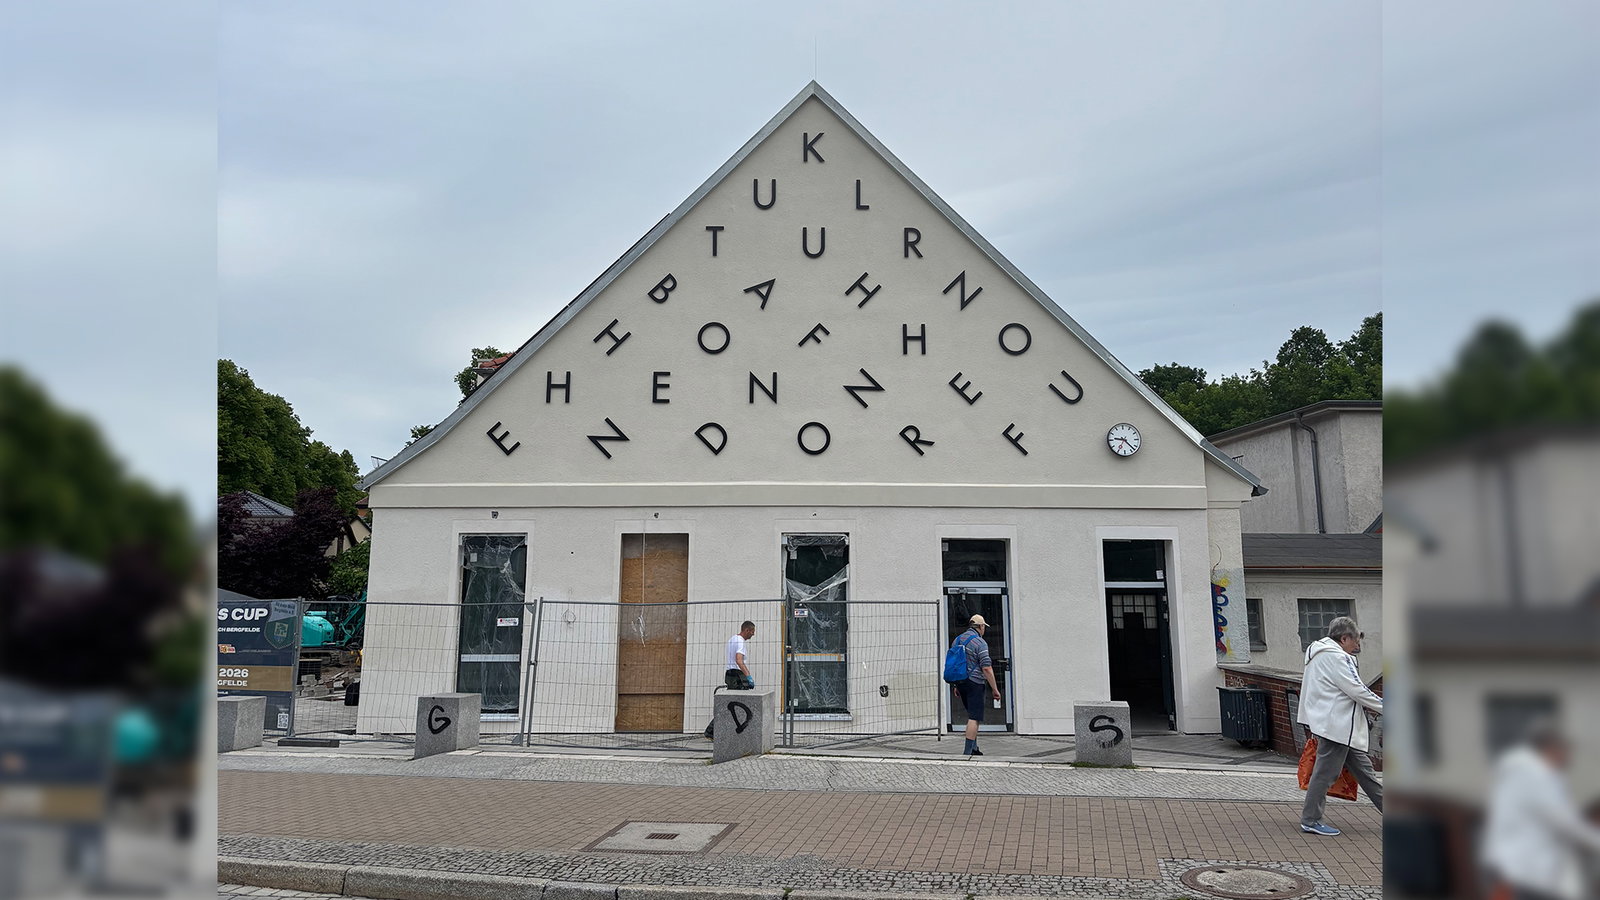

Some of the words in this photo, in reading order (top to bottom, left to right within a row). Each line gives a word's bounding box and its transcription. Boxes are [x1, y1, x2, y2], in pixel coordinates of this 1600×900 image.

[231, 607, 269, 621] CUP
[218, 668, 249, 678] 2026
[427, 704, 451, 735] G
[727, 701, 753, 734] D
[1088, 714, 1124, 749] S
